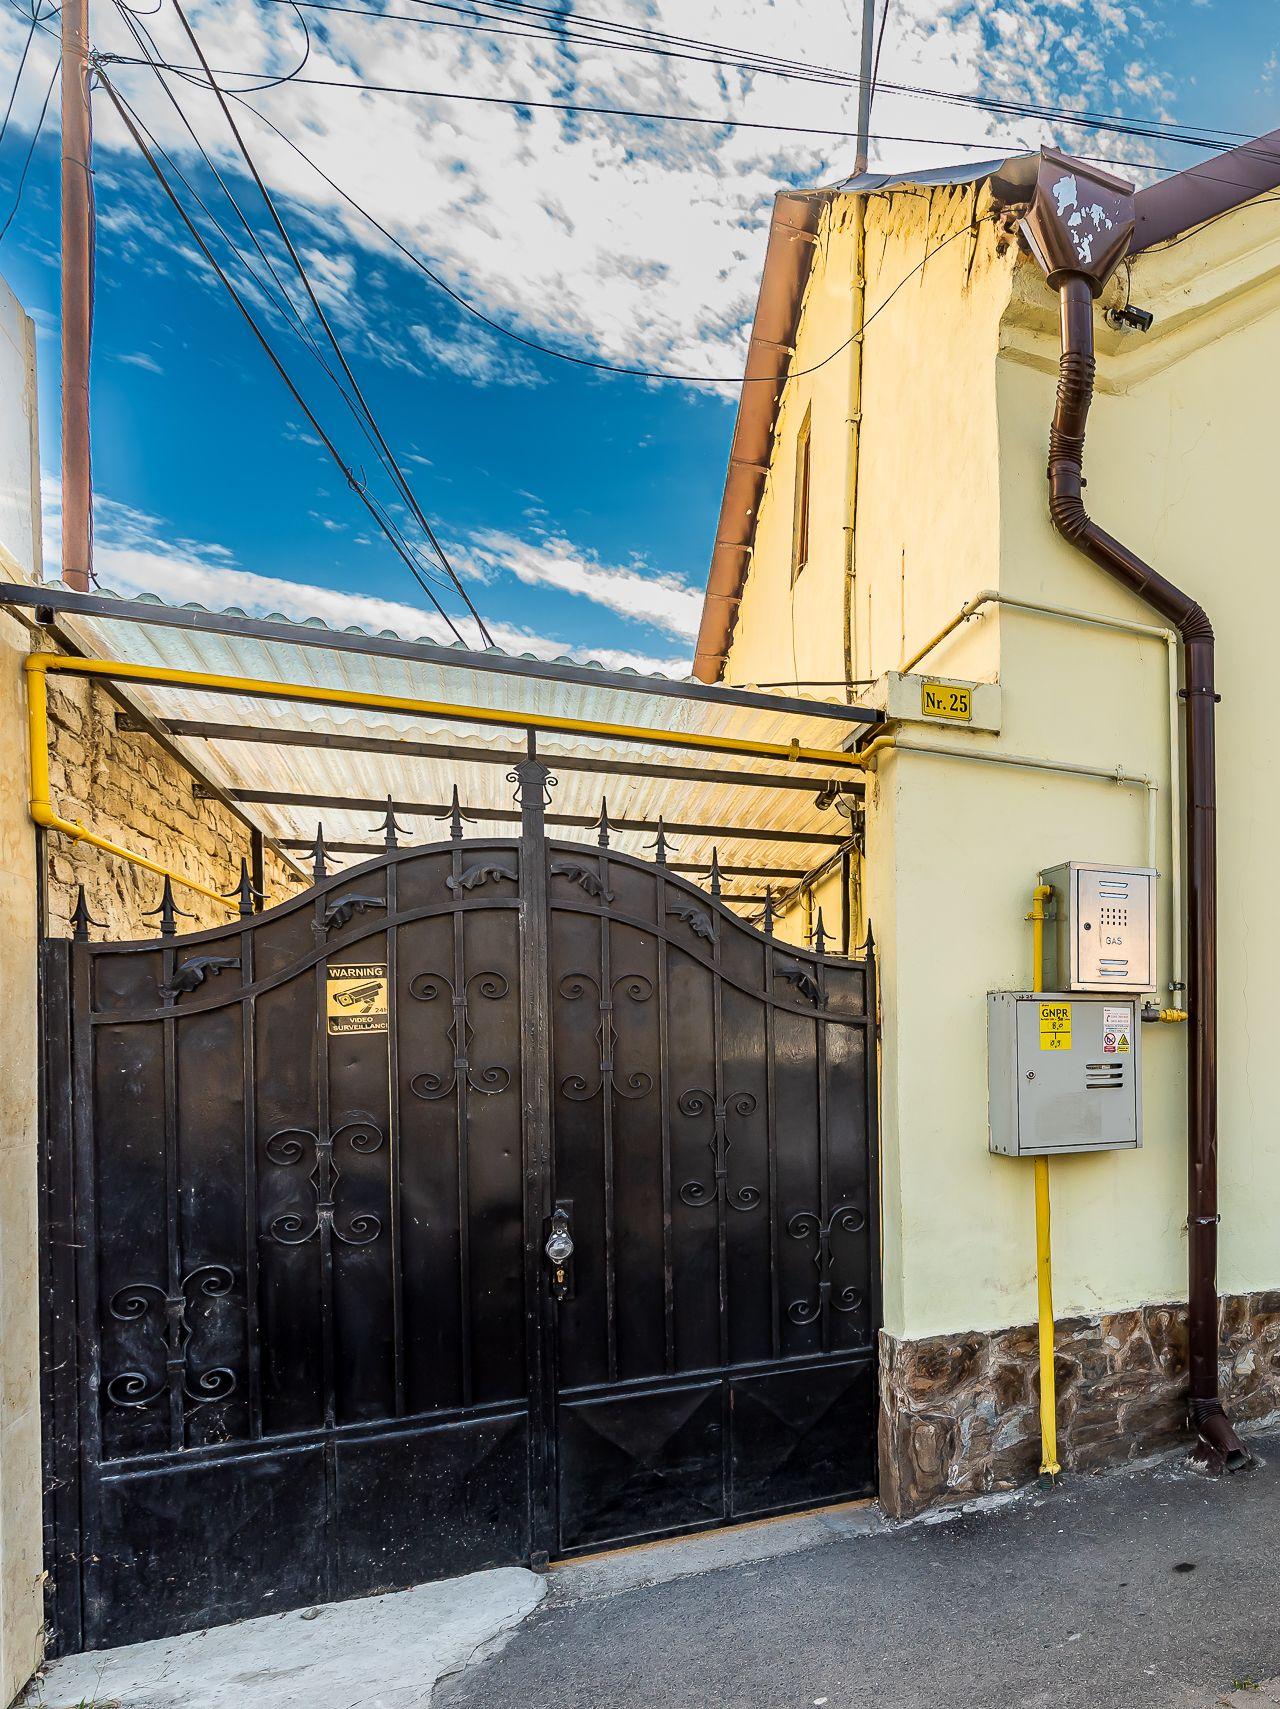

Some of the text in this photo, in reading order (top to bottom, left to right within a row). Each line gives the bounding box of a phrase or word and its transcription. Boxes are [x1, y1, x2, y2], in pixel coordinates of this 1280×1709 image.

[925, 691, 968, 713] Nr. 25
[1105, 936, 1123, 945] GAS
[329, 967, 383, 978] WARNING
[1042, 1008, 1068, 1018] GNPR
[332, 1023, 388, 1031] SURVEILLANC
